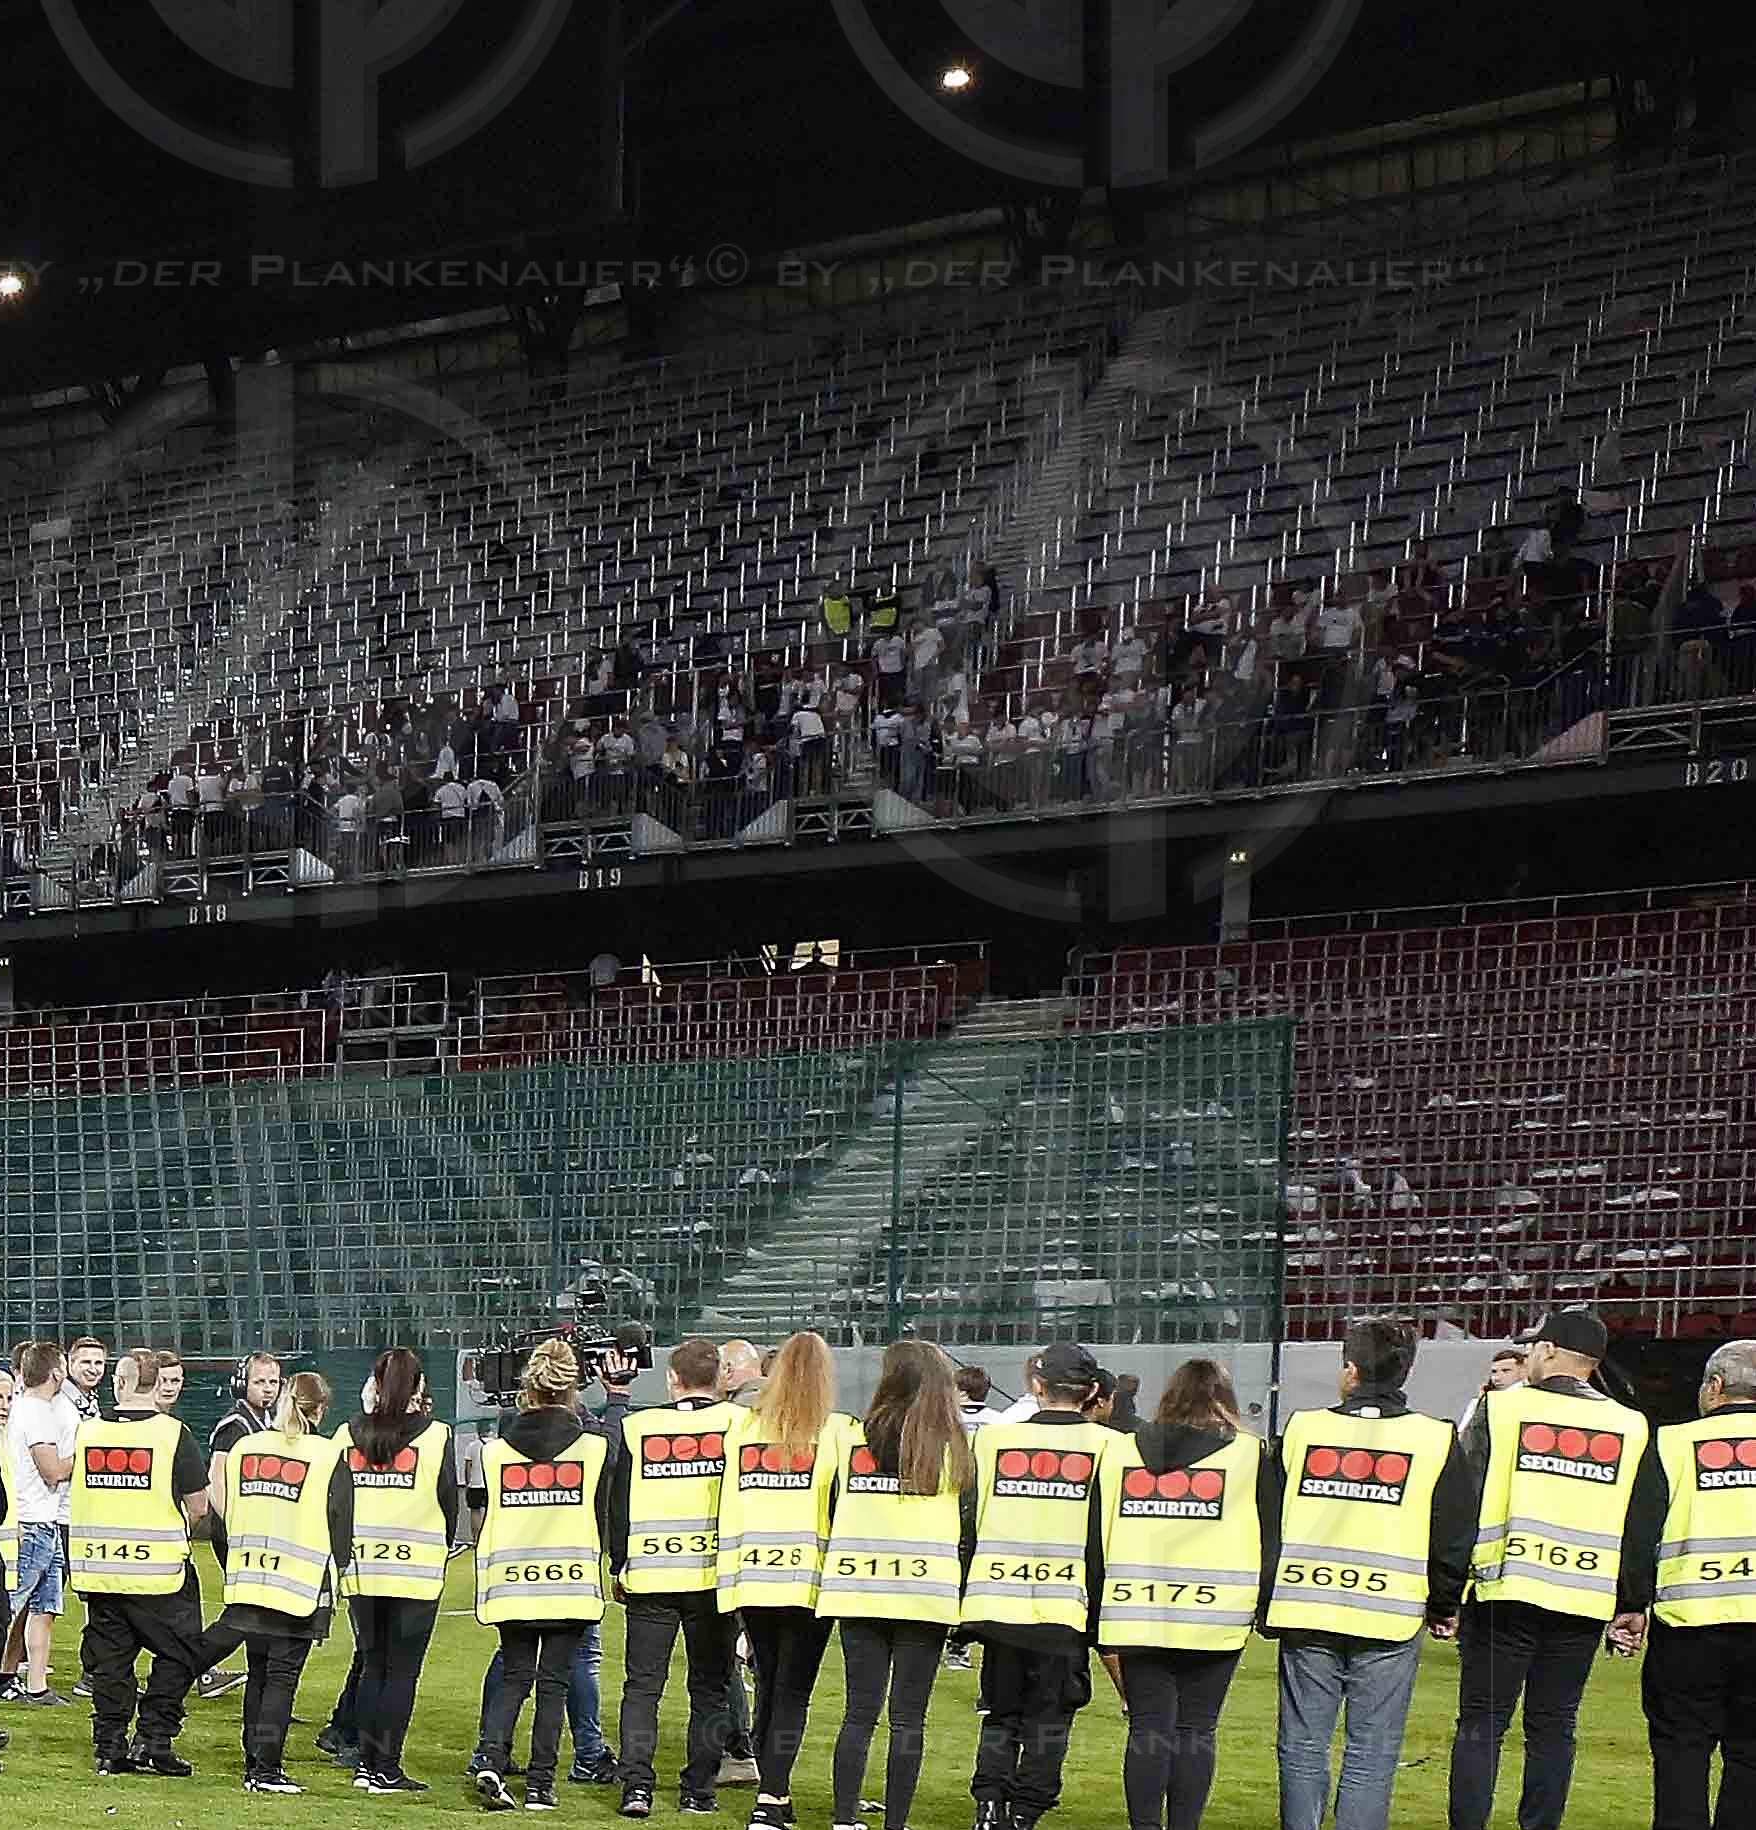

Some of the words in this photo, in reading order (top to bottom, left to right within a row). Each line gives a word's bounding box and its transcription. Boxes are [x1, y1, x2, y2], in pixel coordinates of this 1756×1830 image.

[643, 1460, 724, 1478] SECURITAS
[1518, 1454, 1616, 1483] SECURITAS
[87, 1473, 150, 1488] SECURITAS
[740, 1471, 811, 1489] SECURITAS
[996, 1479, 1087, 1499] SECURITAS
[502, 1490, 581, 1506] SECURITAS
[1301, 1478, 1401, 1503] SECURITAS
[1122, 1499, 1220, 1518] SECURITAS
[84, 1543, 152, 1561] 5145
[1506, 1537, 1599, 1572] 5168
[505, 1563, 584, 1582] 5666
[837, 1557, 929, 1578] 5113
[988, 1561, 1077, 1582] 5464
[1282, 1564, 1389, 1593] 5695
[1111, 1583, 1217, 1605] 5175
